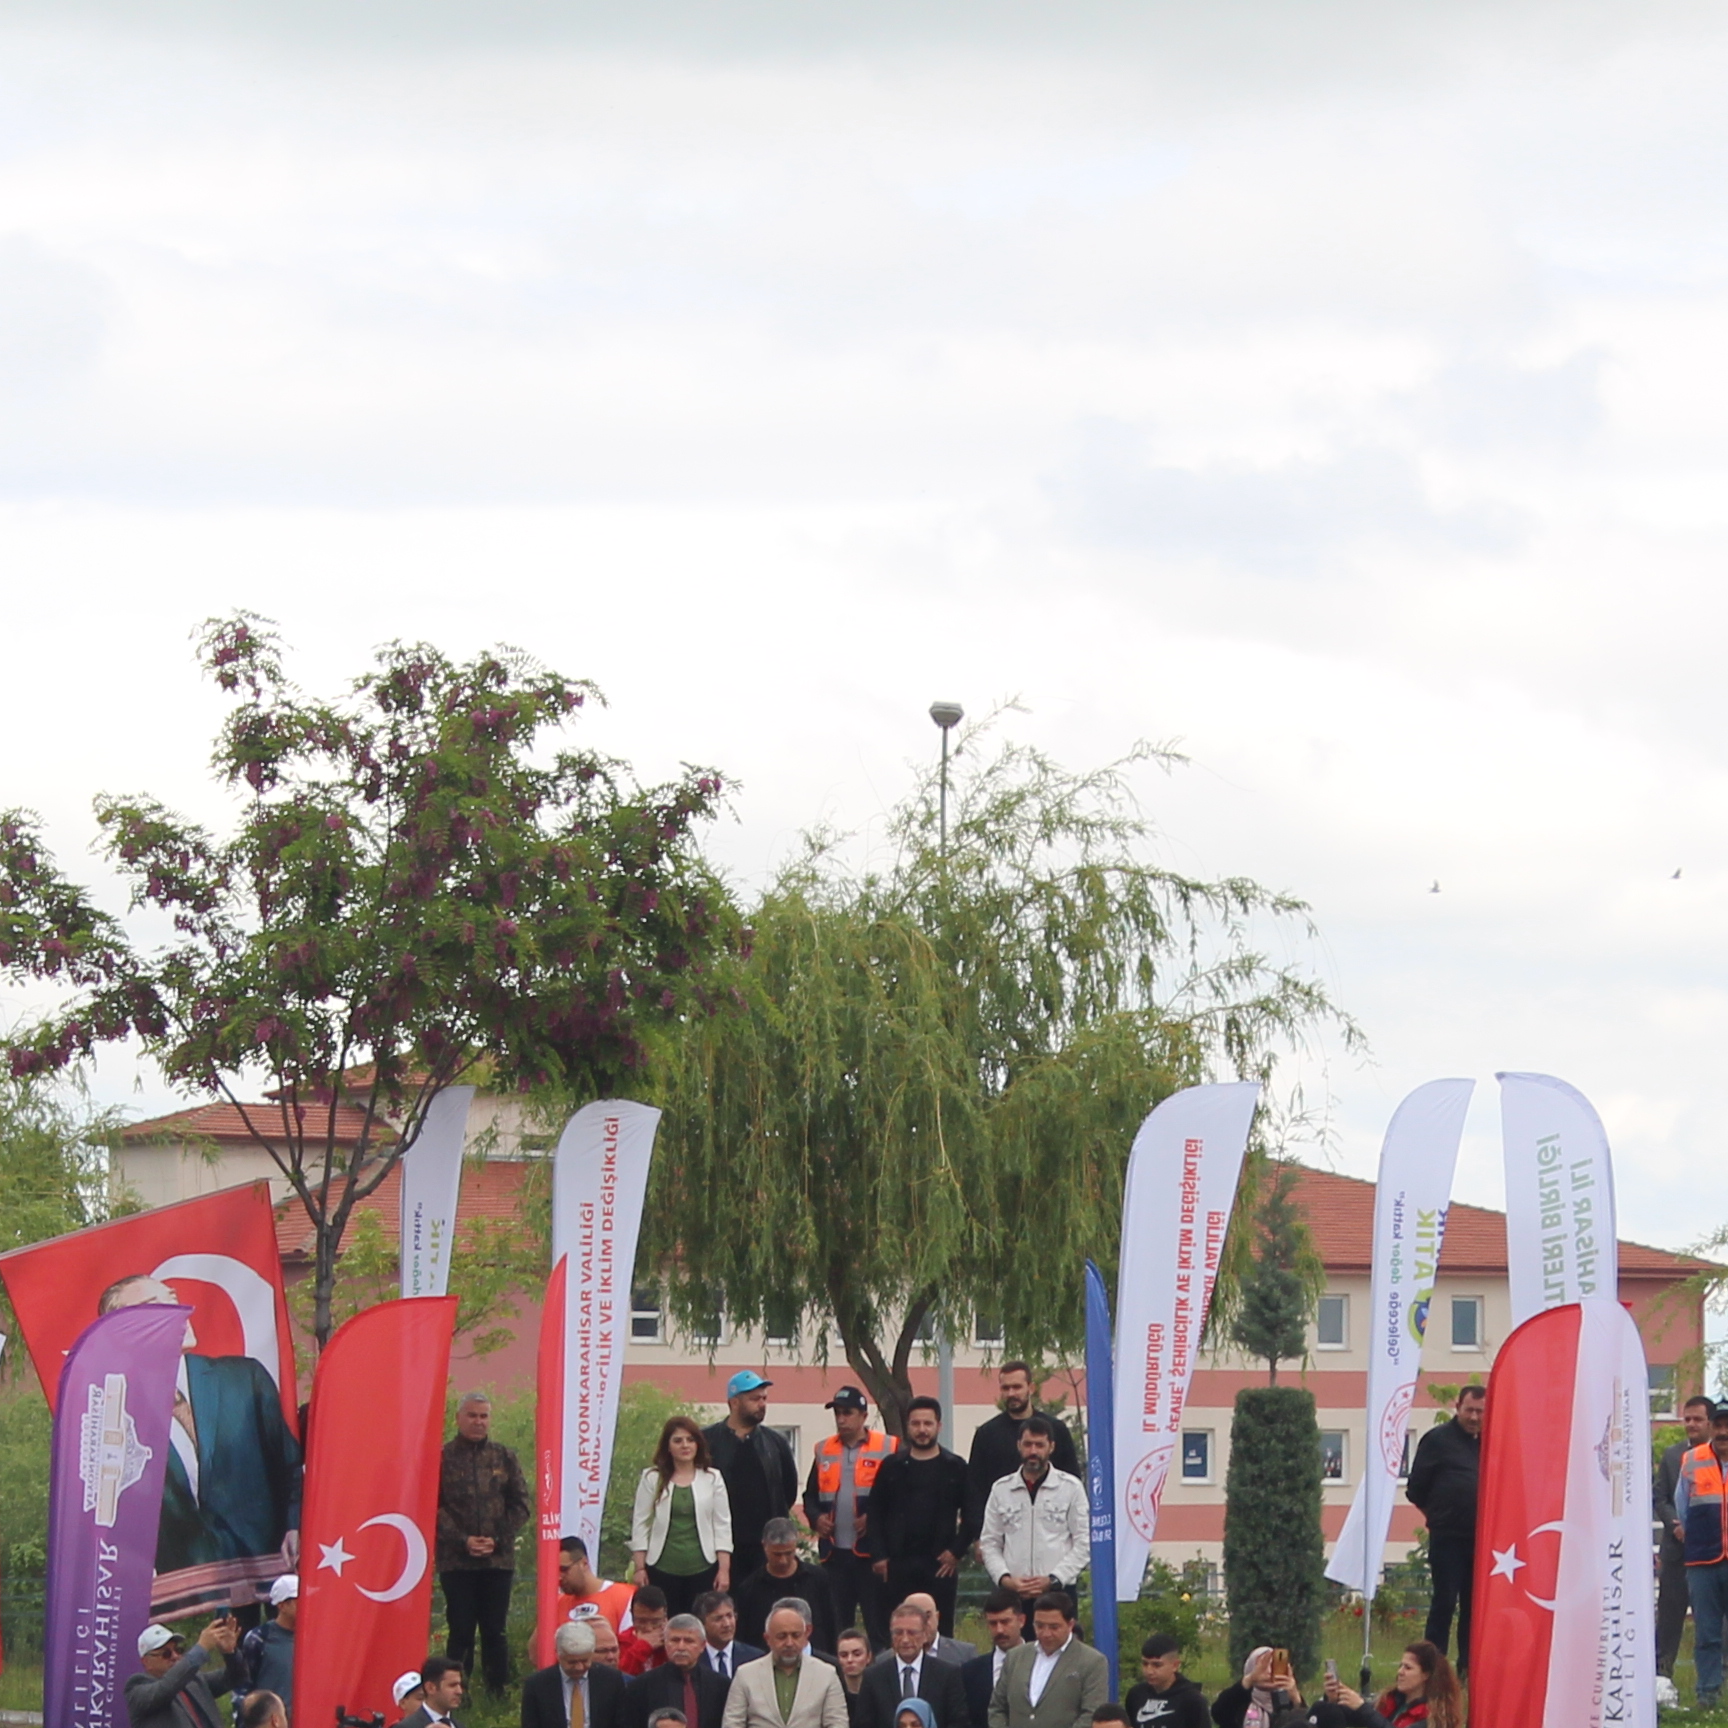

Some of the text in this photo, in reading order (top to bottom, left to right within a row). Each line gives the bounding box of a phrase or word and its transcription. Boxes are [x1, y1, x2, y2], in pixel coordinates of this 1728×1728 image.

[600, 1117, 619, 1232] DEĞİŞİKLİĞİ
[579, 1202, 594, 1284] VALİLİĞİ
[597, 1239, 613, 1293] İKLİM
[600, 1301, 612, 1325] VE
[578, 1289, 592, 1471] AFYONKARAHİSAR
[586, 1489, 600, 1504] İL
[1592, 1586, 1610, 1705] CUMHURİYETİ
[1142, 1699, 1168, 1712] NIKE
